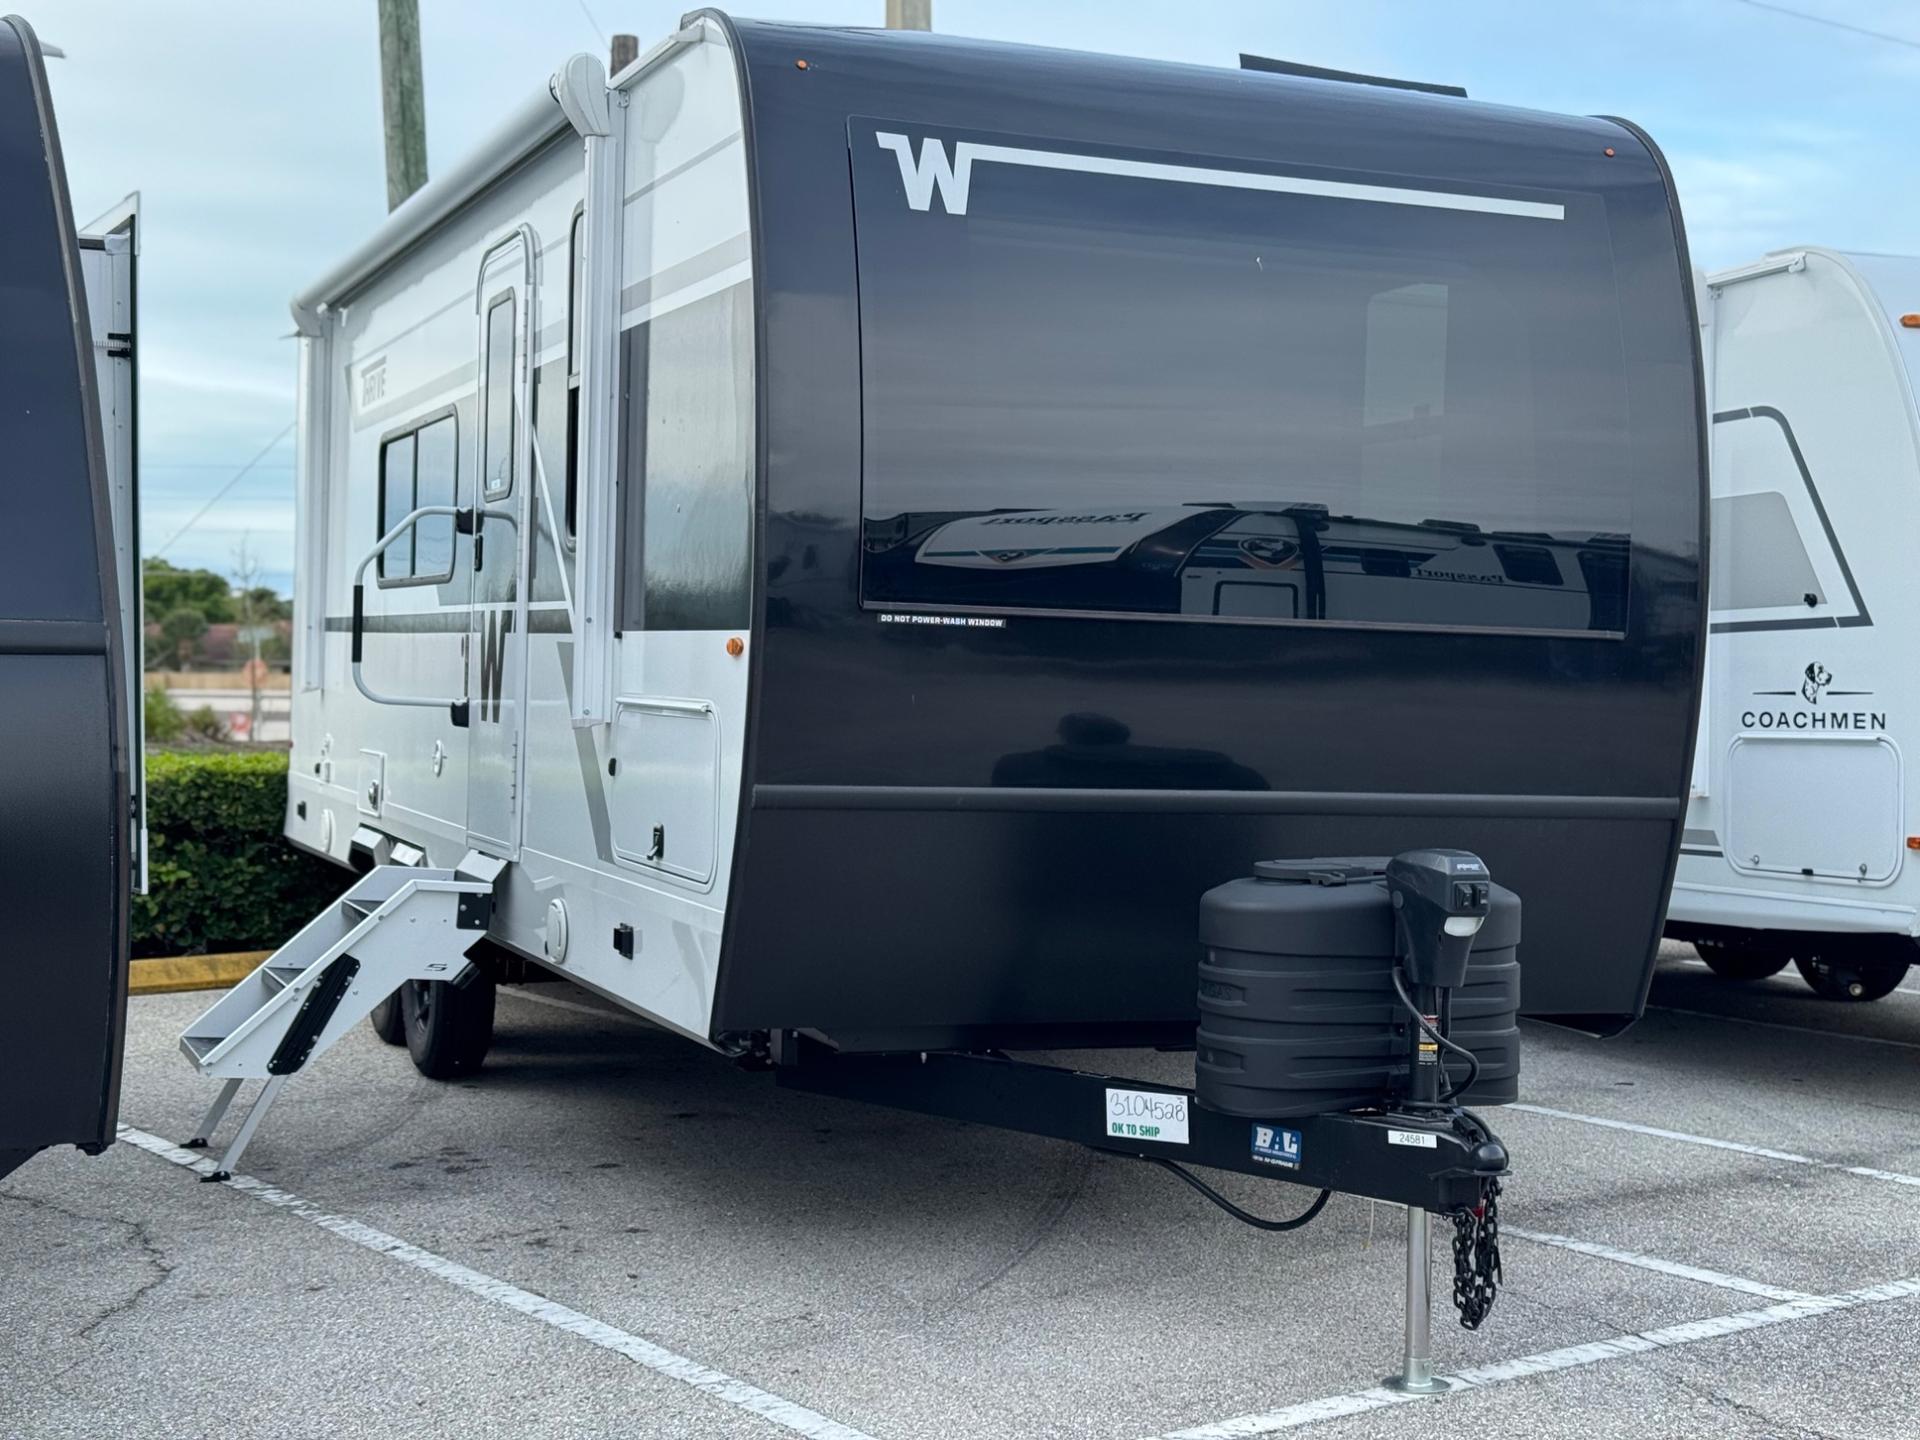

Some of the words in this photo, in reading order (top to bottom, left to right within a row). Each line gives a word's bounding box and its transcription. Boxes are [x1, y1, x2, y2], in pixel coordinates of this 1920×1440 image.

[876, 131, 972, 215] W
[881, 614, 892, 622] DO
[894, 614, 911, 623] NOT
[912, 615, 966, 626] POWER-WASH
[968, 618, 1003, 627] WINDOW
[1741, 711, 1886, 730] COACHMEN
[1110, 1093, 1186, 1122] 3104528
[1111, 1122, 1125, 1134] OK
[1126, 1123, 1137, 1136] TO
[1139, 1125, 1160, 1137] SHIP
